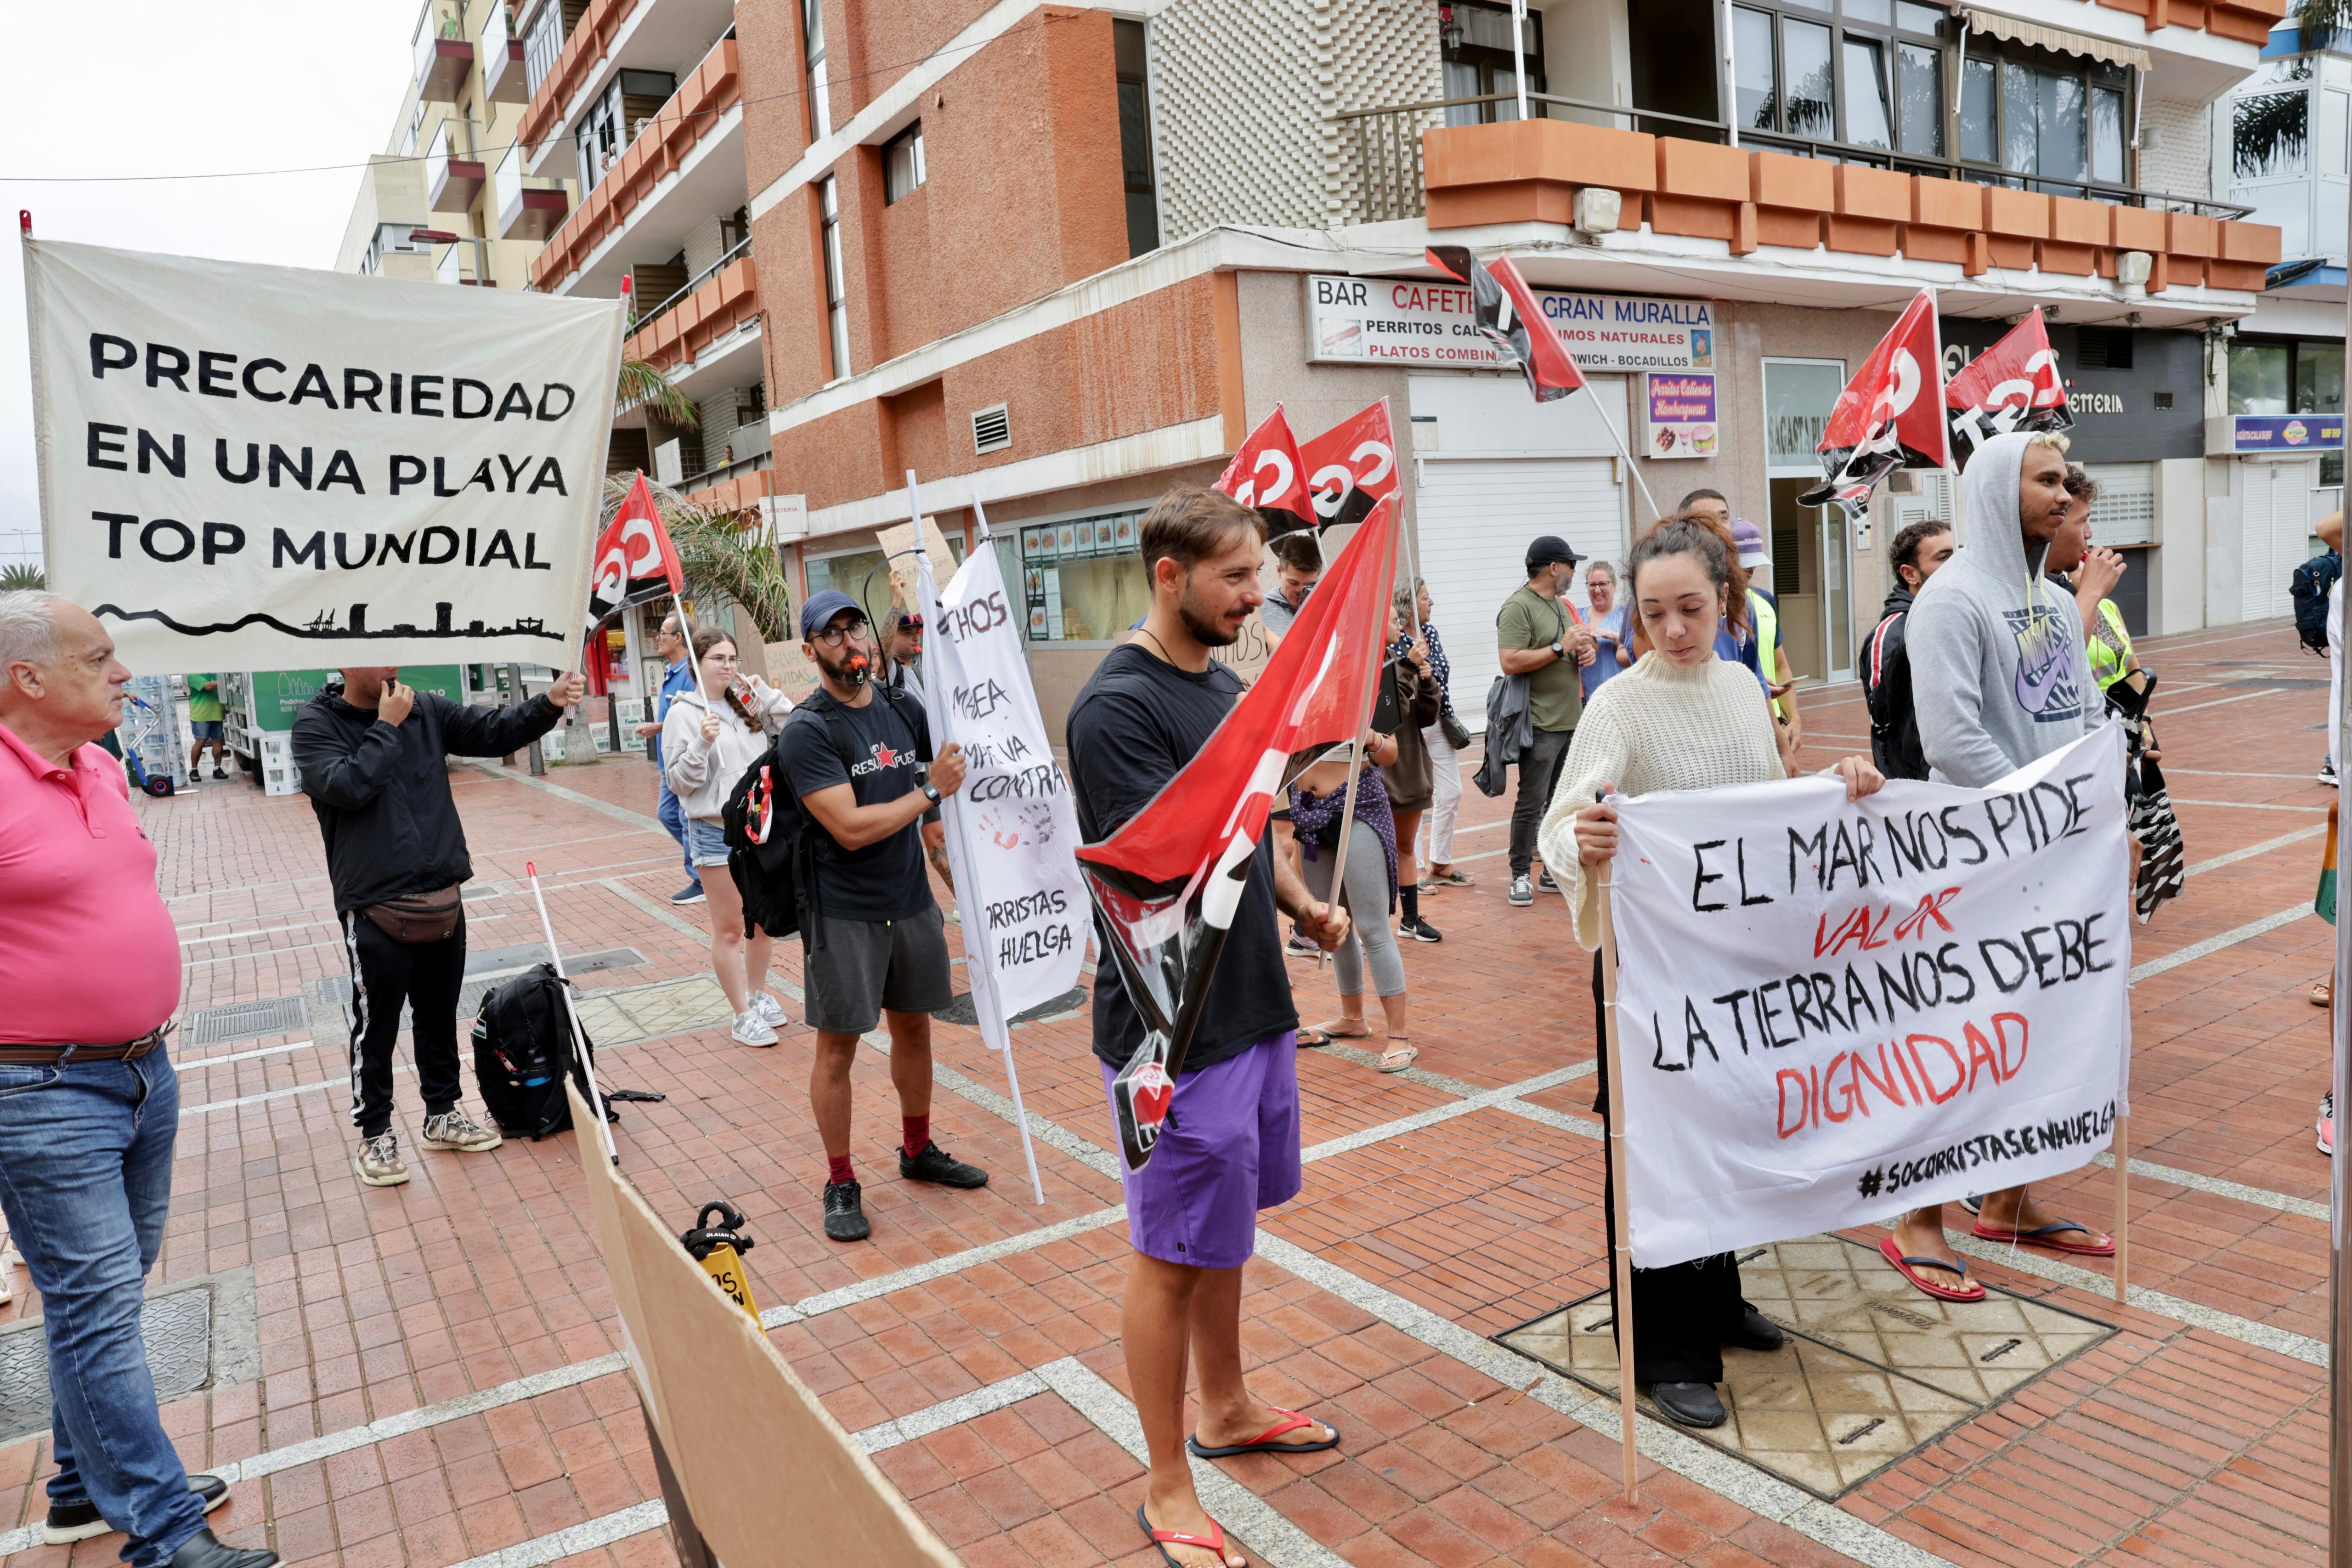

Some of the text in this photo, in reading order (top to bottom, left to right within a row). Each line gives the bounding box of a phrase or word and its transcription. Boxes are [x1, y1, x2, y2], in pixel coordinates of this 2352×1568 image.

[1317, 281, 1367, 306] BAR
[1392, 285, 1474, 314] CAFETE
[1543, 297, 1710, 326] GRAN MURALLA
[1366, 320, 1482, 337] PERRITOS CAL
[1601, 332, 1684, 345] NATURALES
[1369, 345, 1430, 358] PLATOS
[1619, 356, 1688, 367] BOCADILLOS
[90, 333, 575, 421] PRECARIEDAD
[1651, 378, 1712, 397] Perritos Calientes
[1655, 399, 1707, 421] Hamburguesas
[87, 422, 568, 497] EN UNA PLAYA
[91, 511, 551, 570] TOP MUNDIAL
[779, 668, 810, 685] VIDAS
[997, 735, 1032, 763] VA
[970, 759, 1067, 803] CONTRA
[1693, 774, 2094, 912] EL MAR NOS PIDE
[1813, 887, 1962, 959] VALOR
[999, 923, 1072, 970] HUELGA
[1652, 912, 2116, 1071] LA TIERRA NOS DEBE
[1776, 1012, 2029, 1139] DIGNIDAD
[1857, 1098, 2115, 1199] #SOCORRISTASENHUELGA
